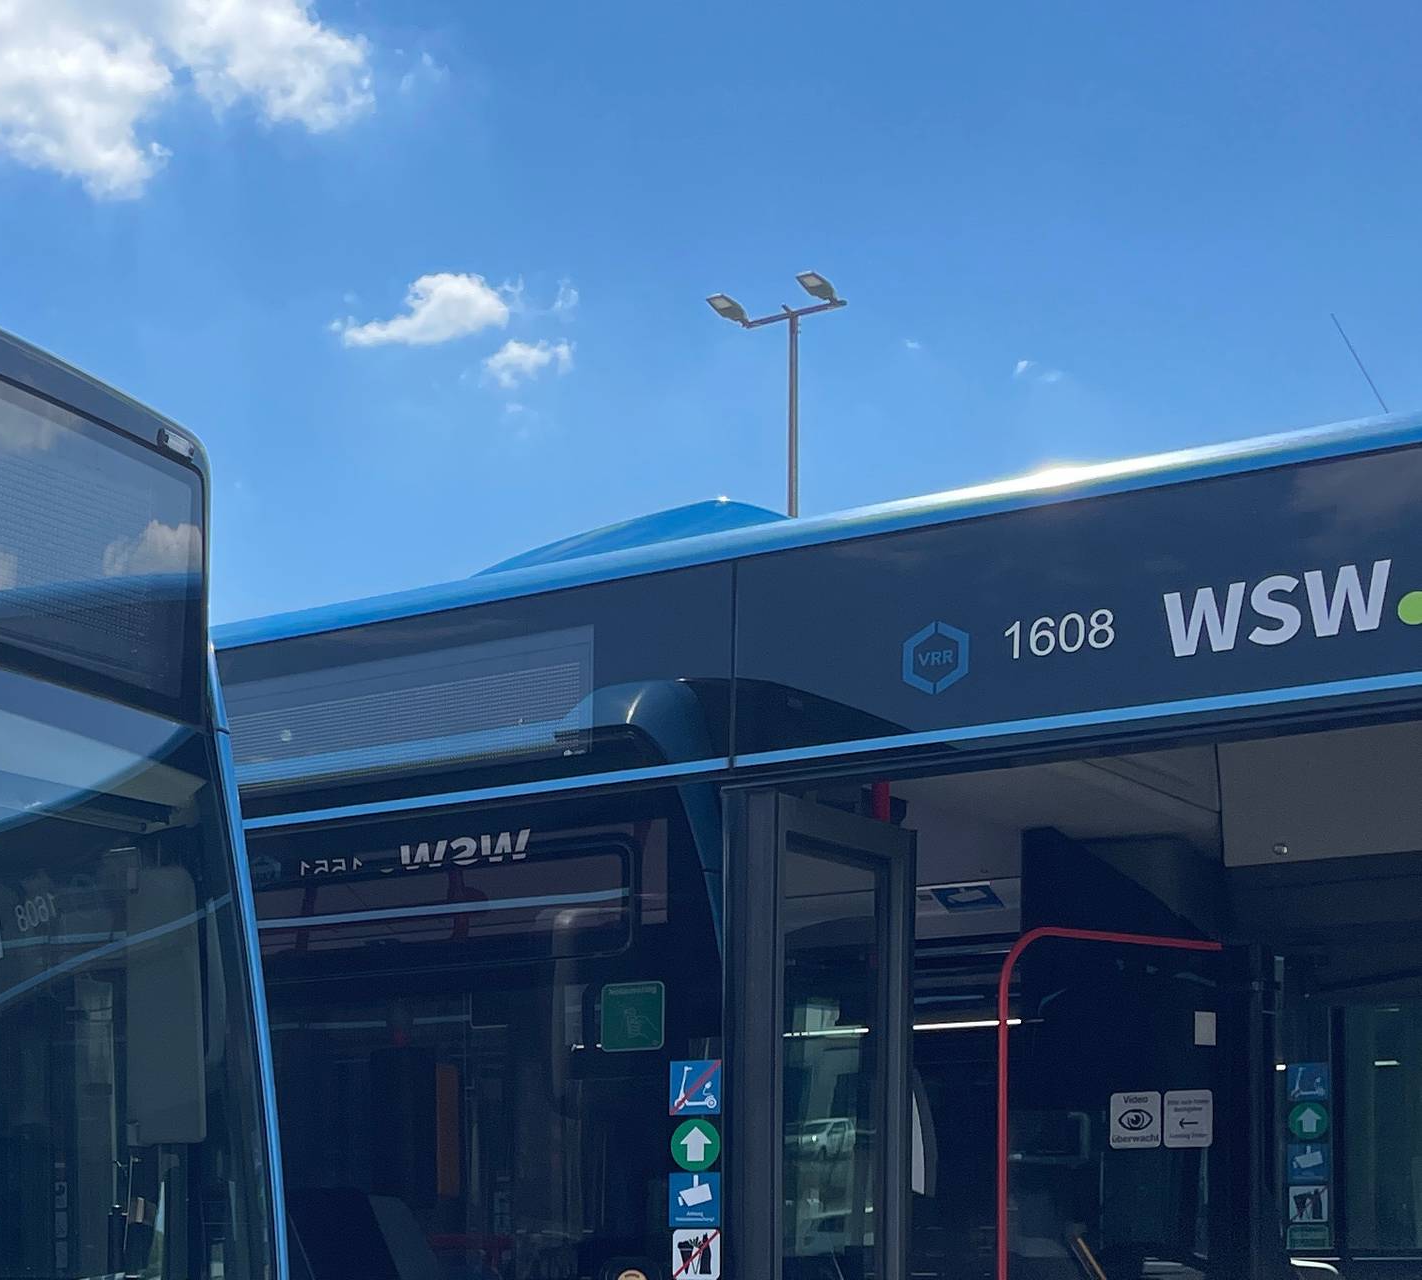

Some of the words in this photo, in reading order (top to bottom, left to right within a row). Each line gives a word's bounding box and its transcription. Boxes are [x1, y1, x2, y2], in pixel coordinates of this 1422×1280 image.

[1003, 608, 1116, 660] 1608
[916, 647, 955, 667] VRR
[1123, 1095, 1149, 1104] Video
[1111, 1133, 1159, 1143] überwacht
